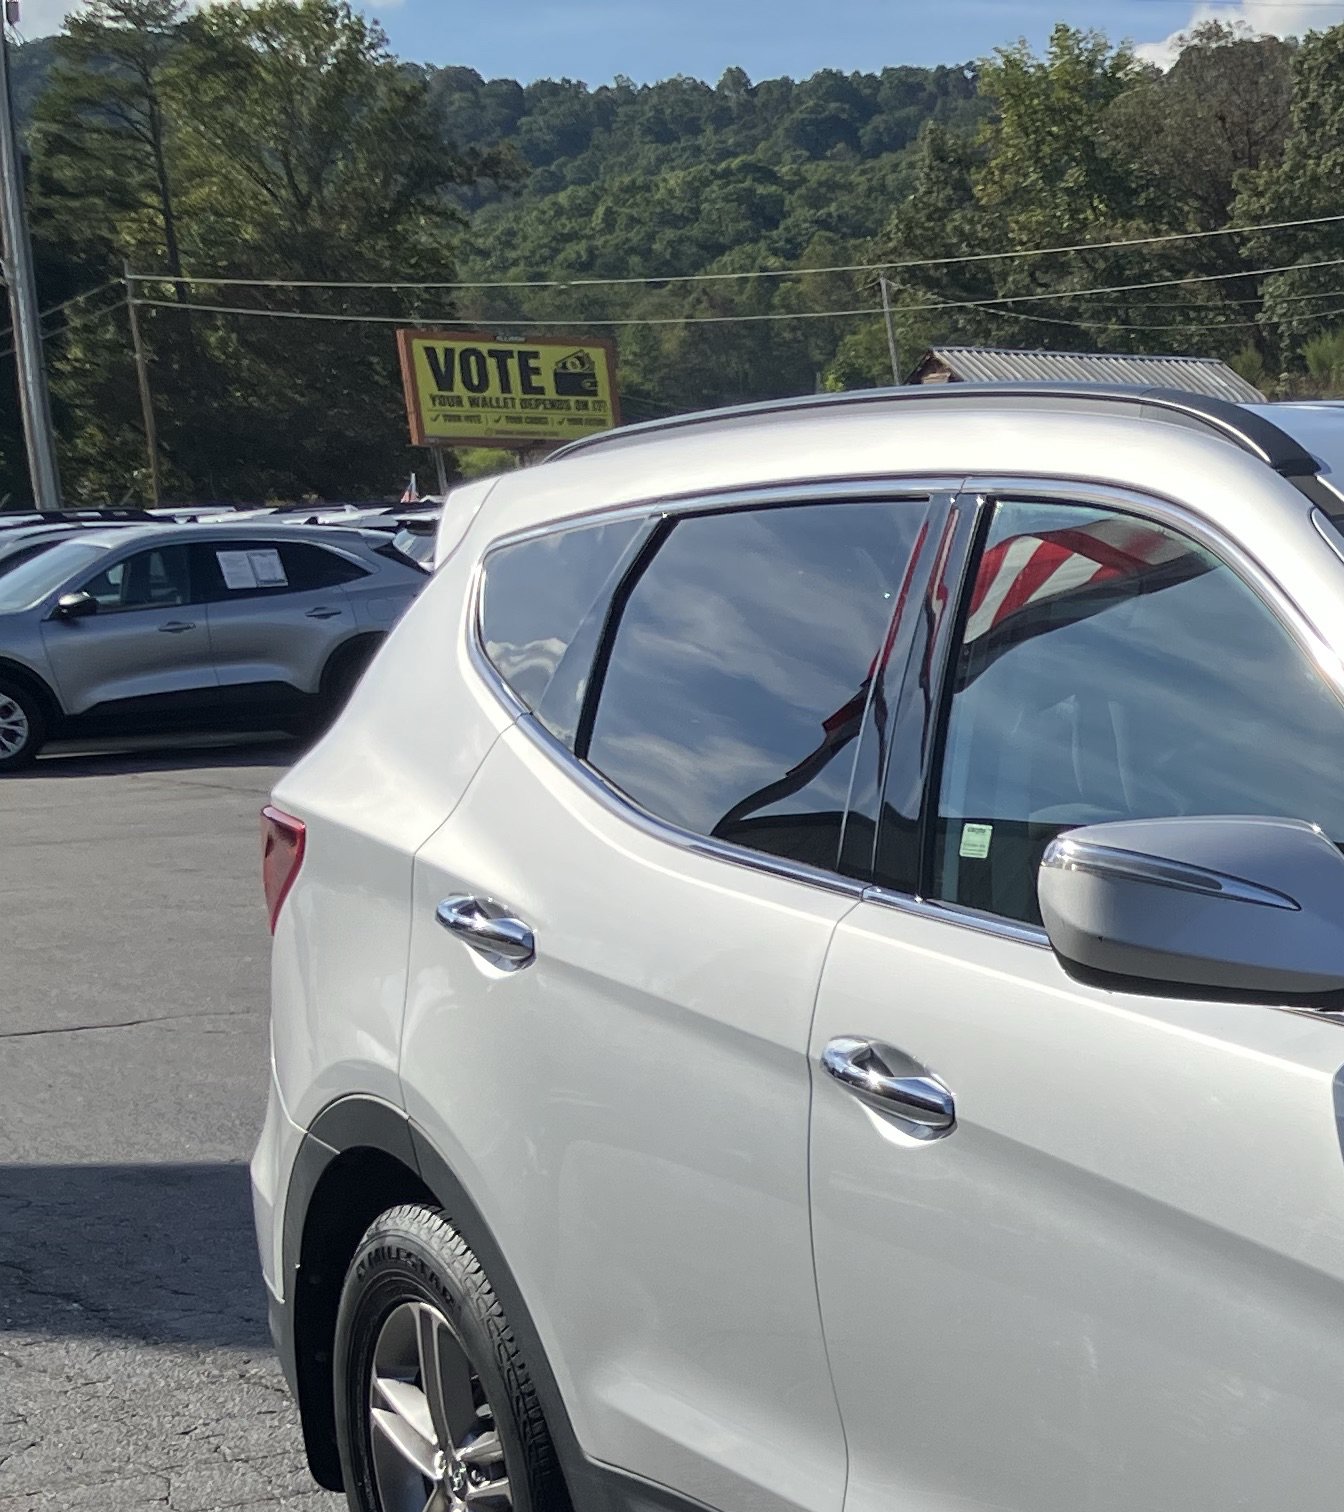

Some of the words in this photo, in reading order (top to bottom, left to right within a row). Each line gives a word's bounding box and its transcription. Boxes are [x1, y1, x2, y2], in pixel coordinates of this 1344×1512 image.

[423, 346, 546, 396] VOTE
[429, 394, 464, 408] YOUR
[467, 396, 516, 410] WALLET
[519, 398, 572, 411] DEPENDS
[367, 1245, 455, 1305] MILESTAR
